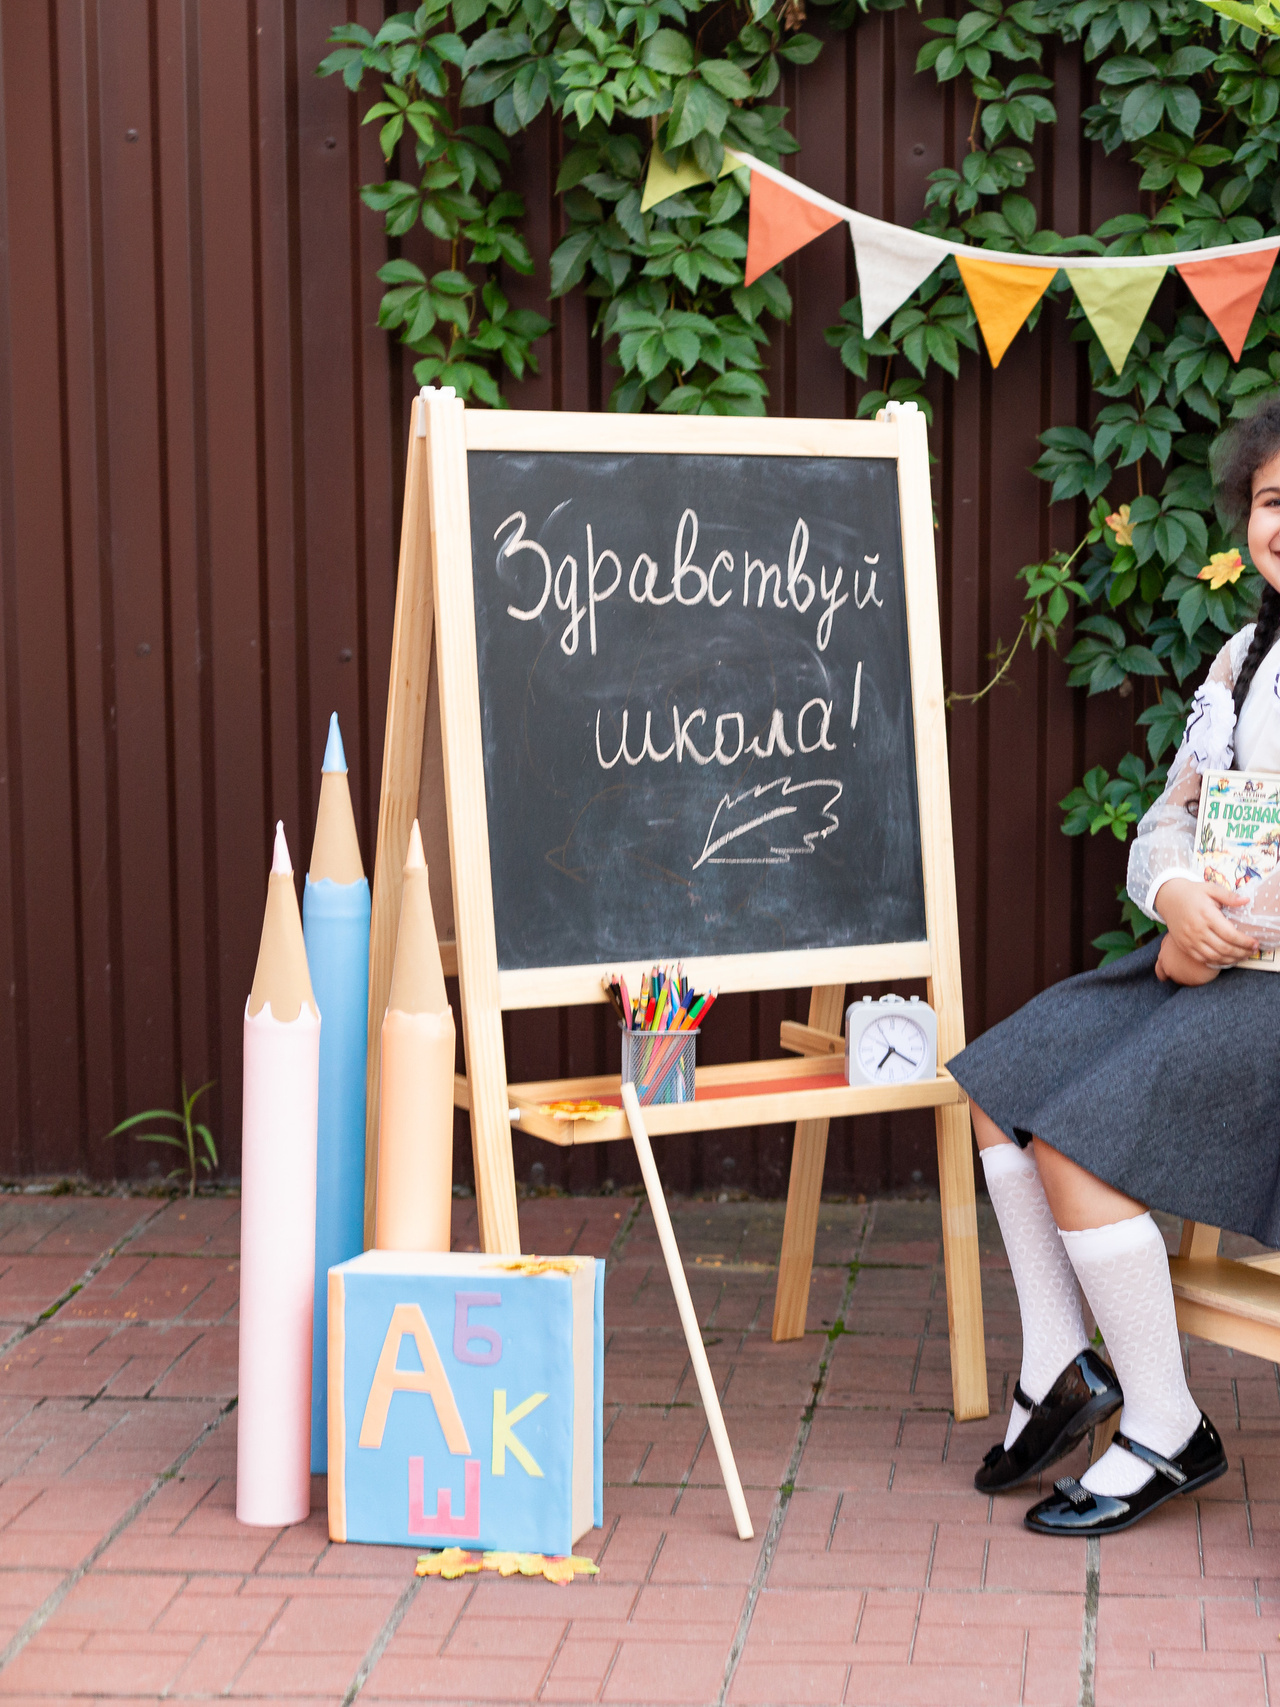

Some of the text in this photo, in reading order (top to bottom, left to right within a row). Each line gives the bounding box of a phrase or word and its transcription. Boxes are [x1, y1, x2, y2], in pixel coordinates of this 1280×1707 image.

[494, 507, 884, 656] Здравствуй
[595, 661, 863, 770] школа!
[1207, 801, 1220, 820] Я
[1225, 822, 1260, 840] МИР
[453, 1291, 503, 1366] Б
[358, 1303, 472, 1456] А
[491, 1388, 550, 1478] К
[408, 1456, 481, 1540] Ш
